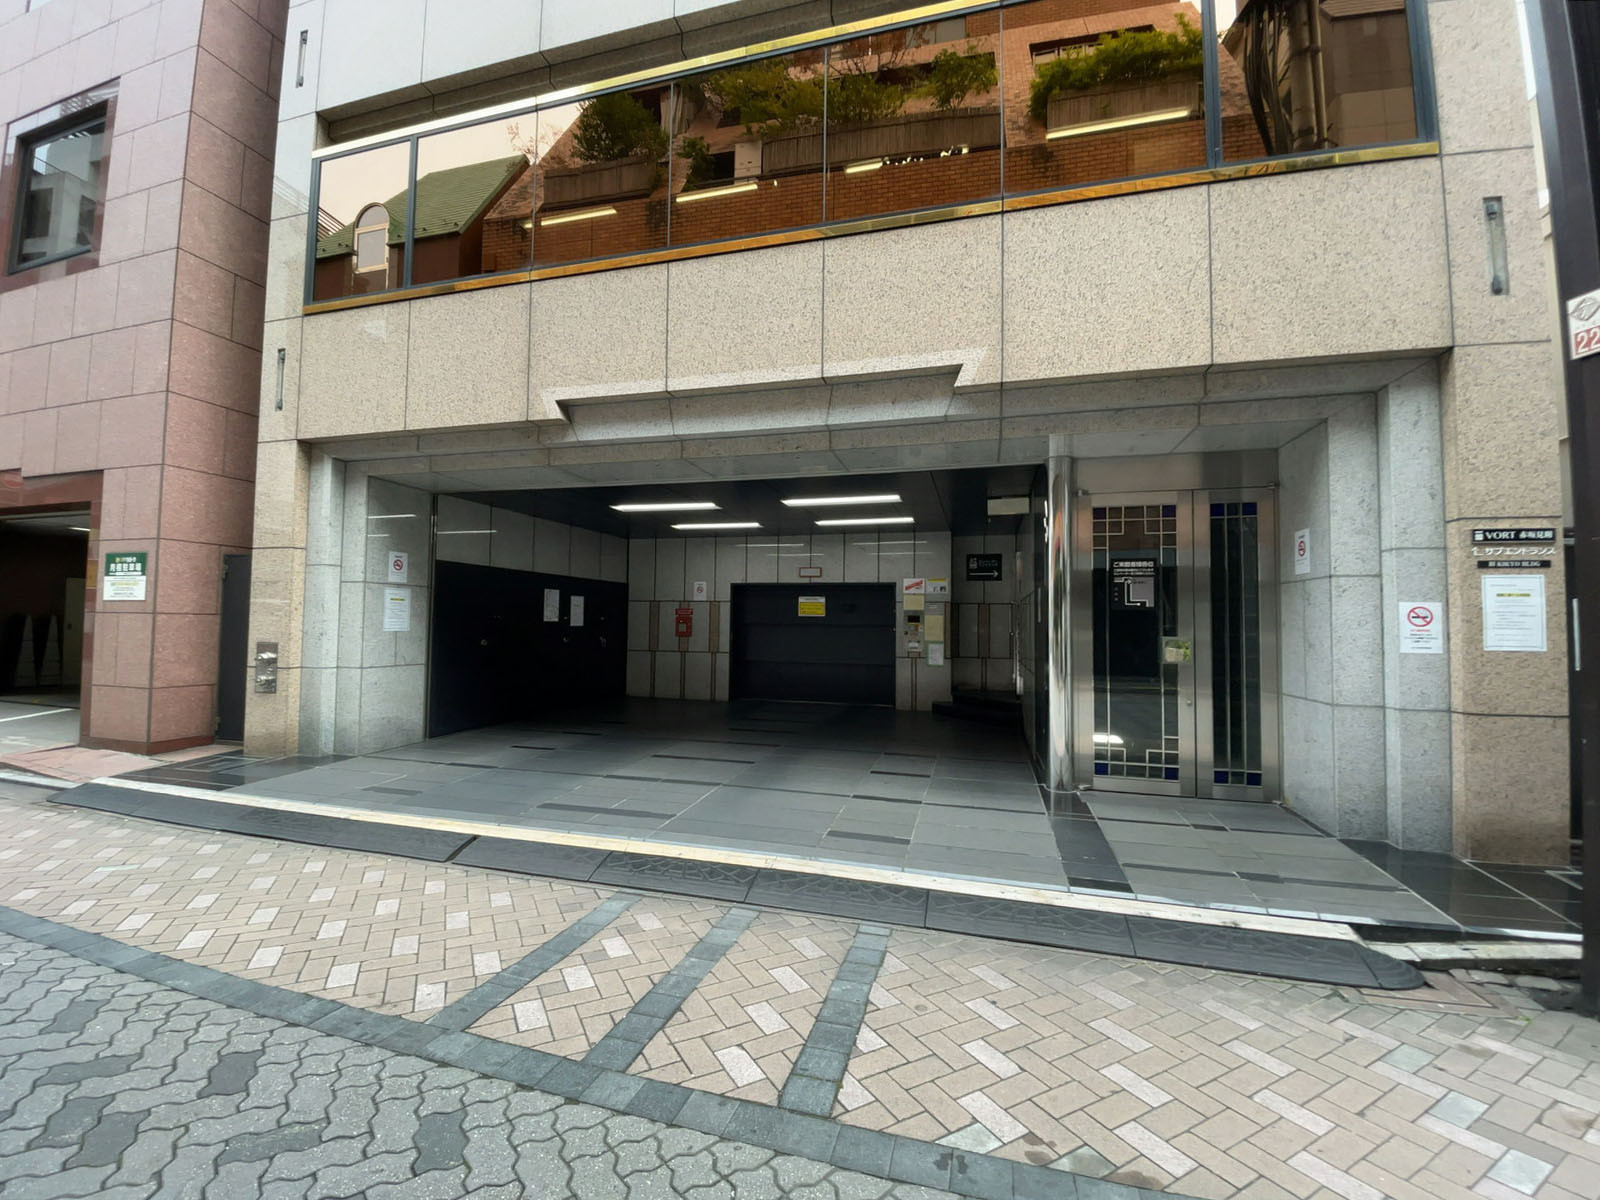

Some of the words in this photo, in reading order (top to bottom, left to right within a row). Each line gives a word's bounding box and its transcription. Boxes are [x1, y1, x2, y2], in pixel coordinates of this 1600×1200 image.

[1485, 531, 1516, 539] VORT
[1485, 546, 1556, 556] サブエントランス
